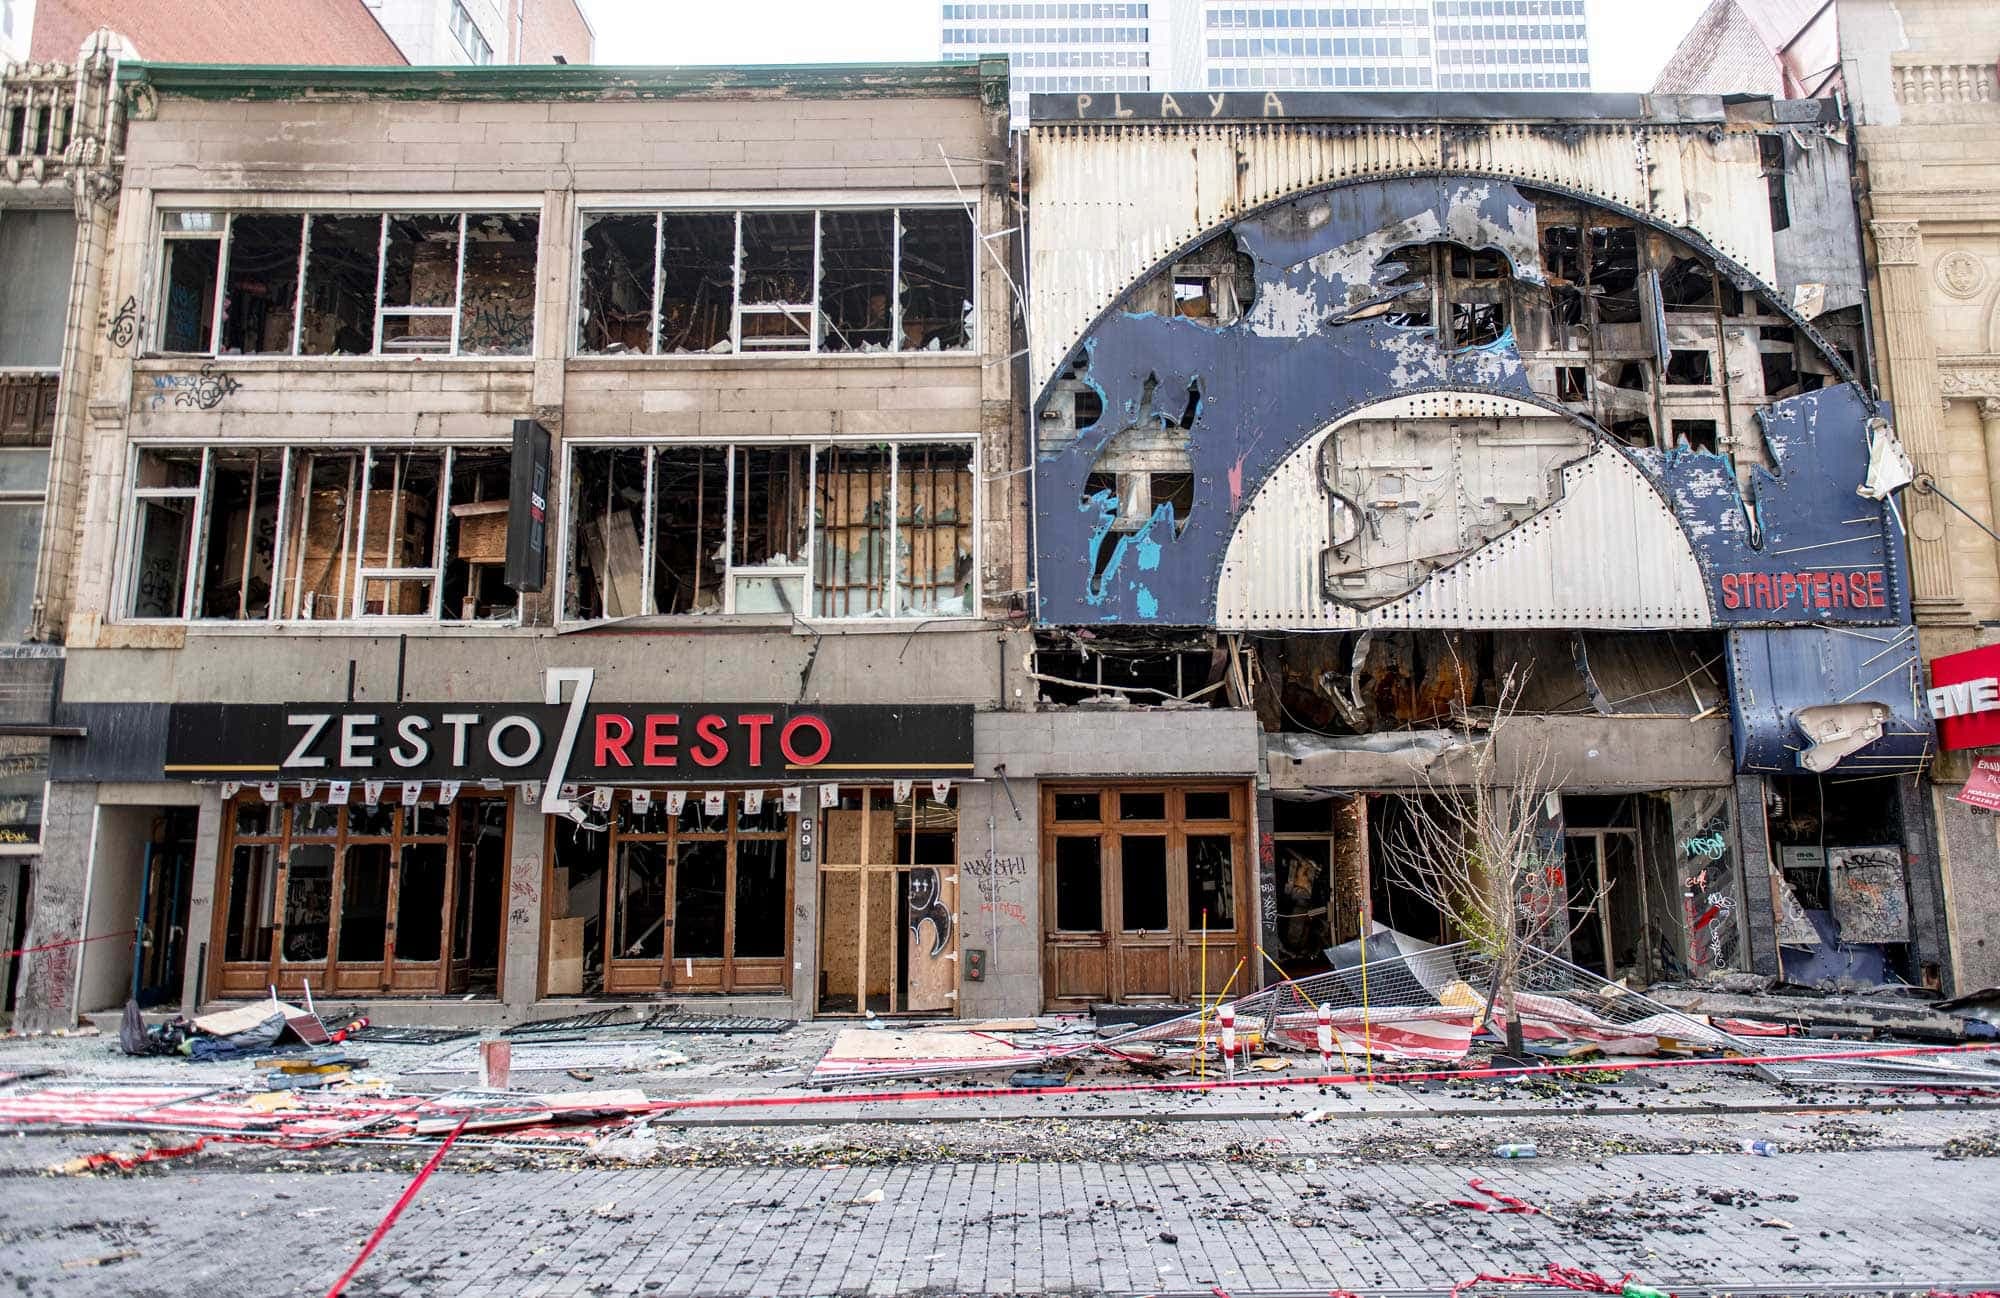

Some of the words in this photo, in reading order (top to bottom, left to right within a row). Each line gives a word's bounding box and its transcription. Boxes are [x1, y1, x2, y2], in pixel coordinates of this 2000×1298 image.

[1077, 92, 1284, 118] PLAYA
[1722, 571, 1887, 609] STRIPTEASE
[1927, 676, 1998, 720] FIVE
[282, 714, 541, 768] ZESTO
[594, 714, 832, 767] RESTO
